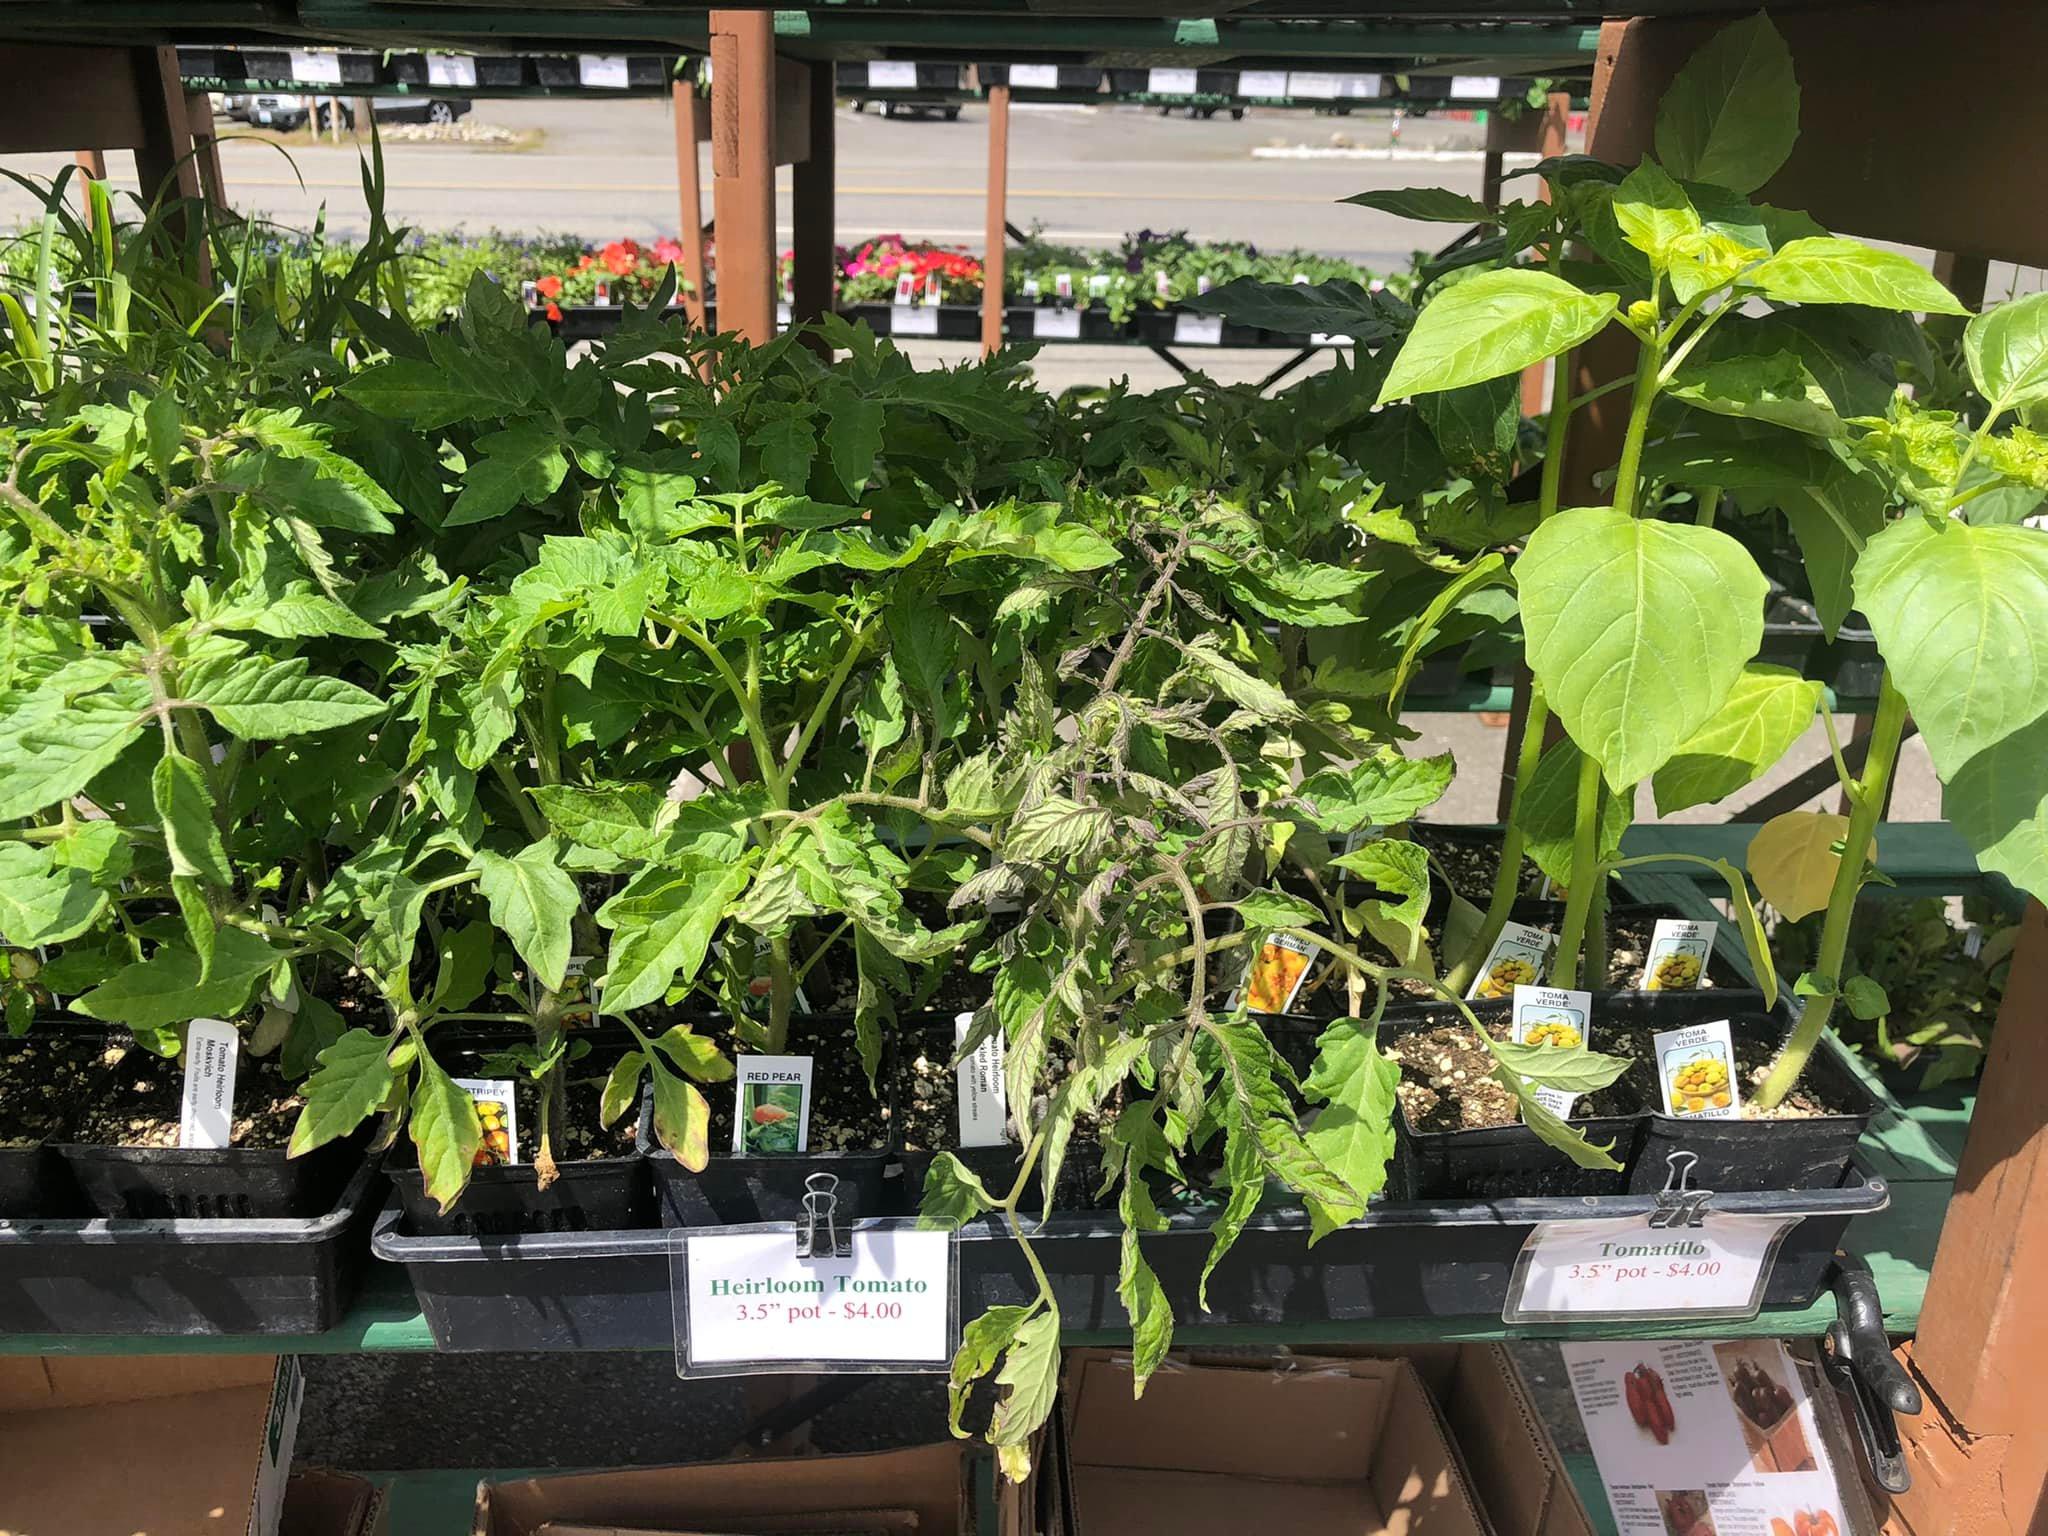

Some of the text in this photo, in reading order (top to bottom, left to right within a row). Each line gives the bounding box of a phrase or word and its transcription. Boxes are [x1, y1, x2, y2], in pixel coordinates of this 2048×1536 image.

[204, 1039, 216, 1078] Moskvich
[214, 1042, 228, 1109] Tomato Heirloom
[747, 1072, 801, 1081] RED PEAR
[980, 1065, 988, 1093] Roman
[991, 1059, 1000, 1094] Heirloom
[1600, 1240, 1705, 1257] Tomatillo
[1615, 1267, 1647, 1282] pot
[1666, 1261, 1721, 1278] $4.00
[710, 1275, 927, 1296] Heirloom Tomato
[788, 1305, 821, 1323] pot
[844, 1301, 902, 1320] $4.00
